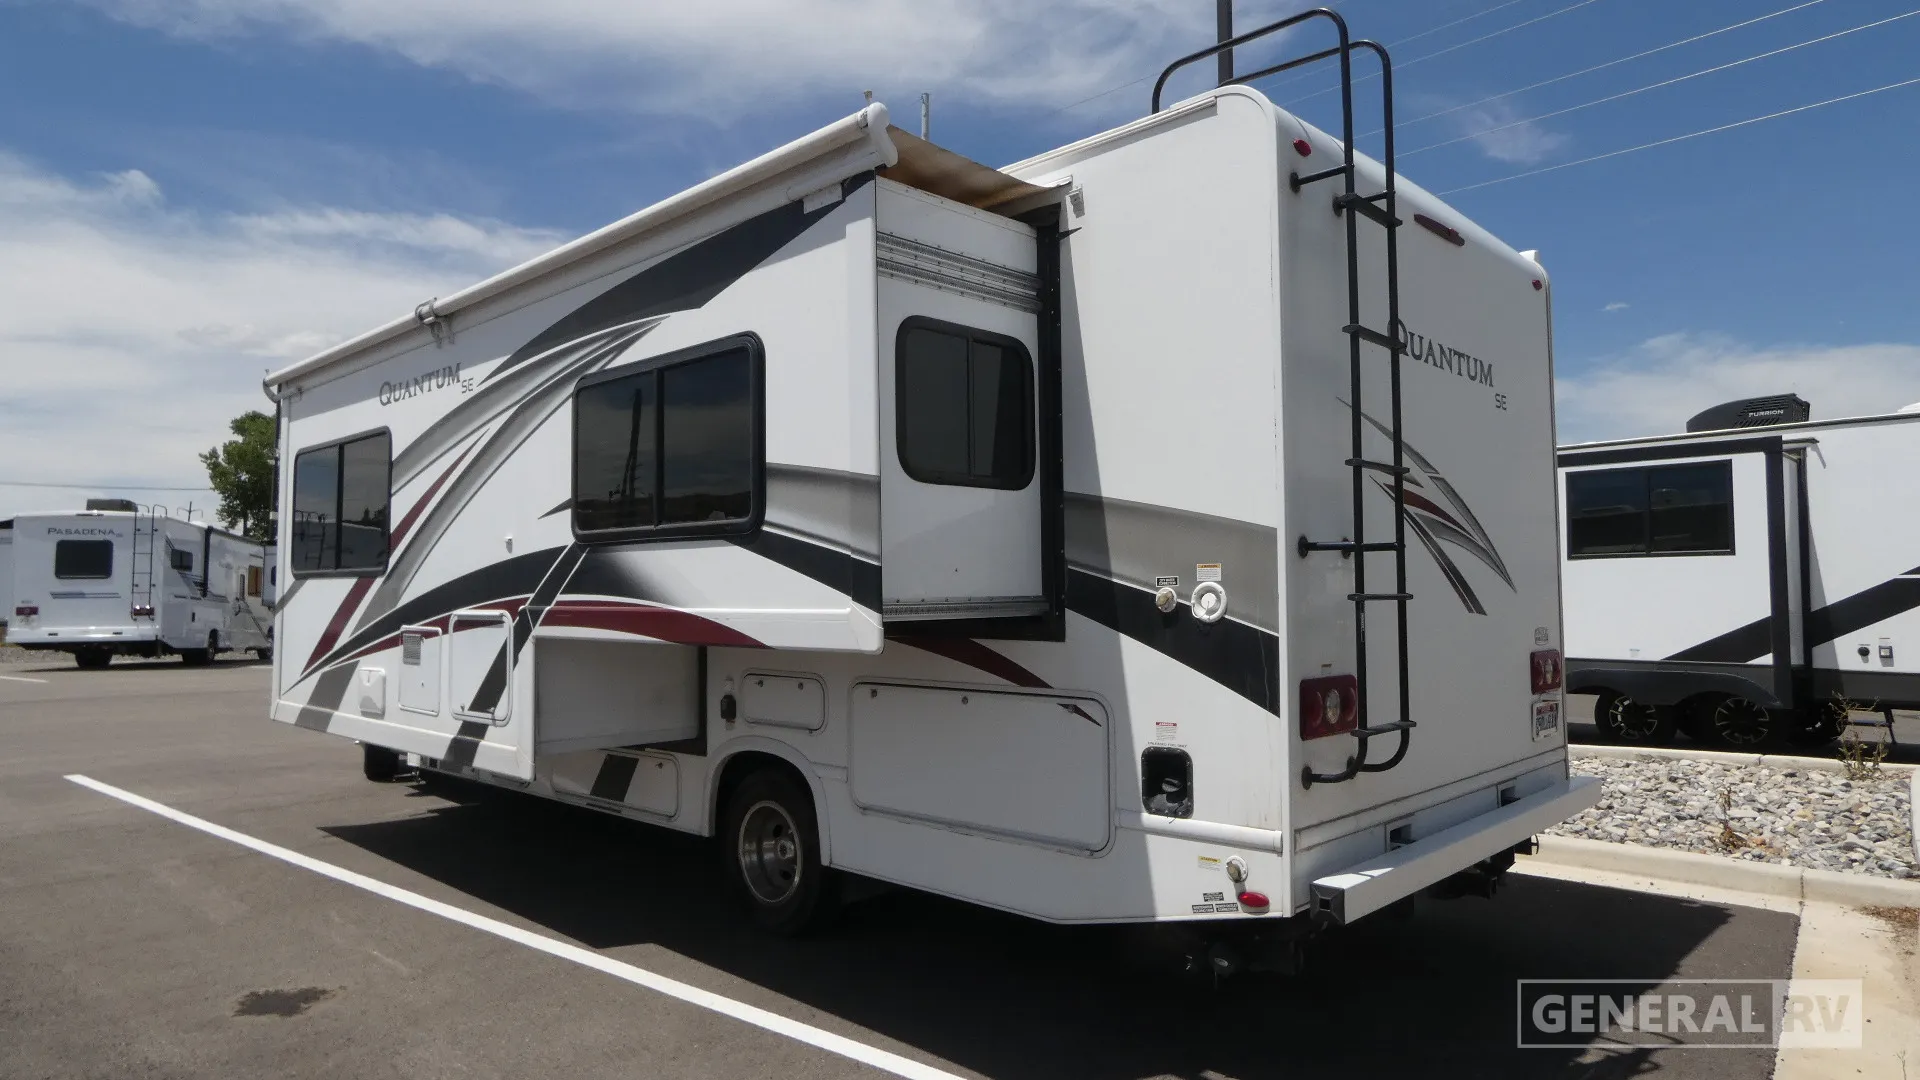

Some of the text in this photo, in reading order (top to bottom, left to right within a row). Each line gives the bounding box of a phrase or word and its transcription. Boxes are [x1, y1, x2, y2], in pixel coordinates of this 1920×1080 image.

[1387, 317, 1506, 410] QUANTUM SE
[379, 362, 474, 406] QUANTUM SE
[1748, 409, 1784, 417] FURRION
[47, 527, 116, 535] PASADENA
